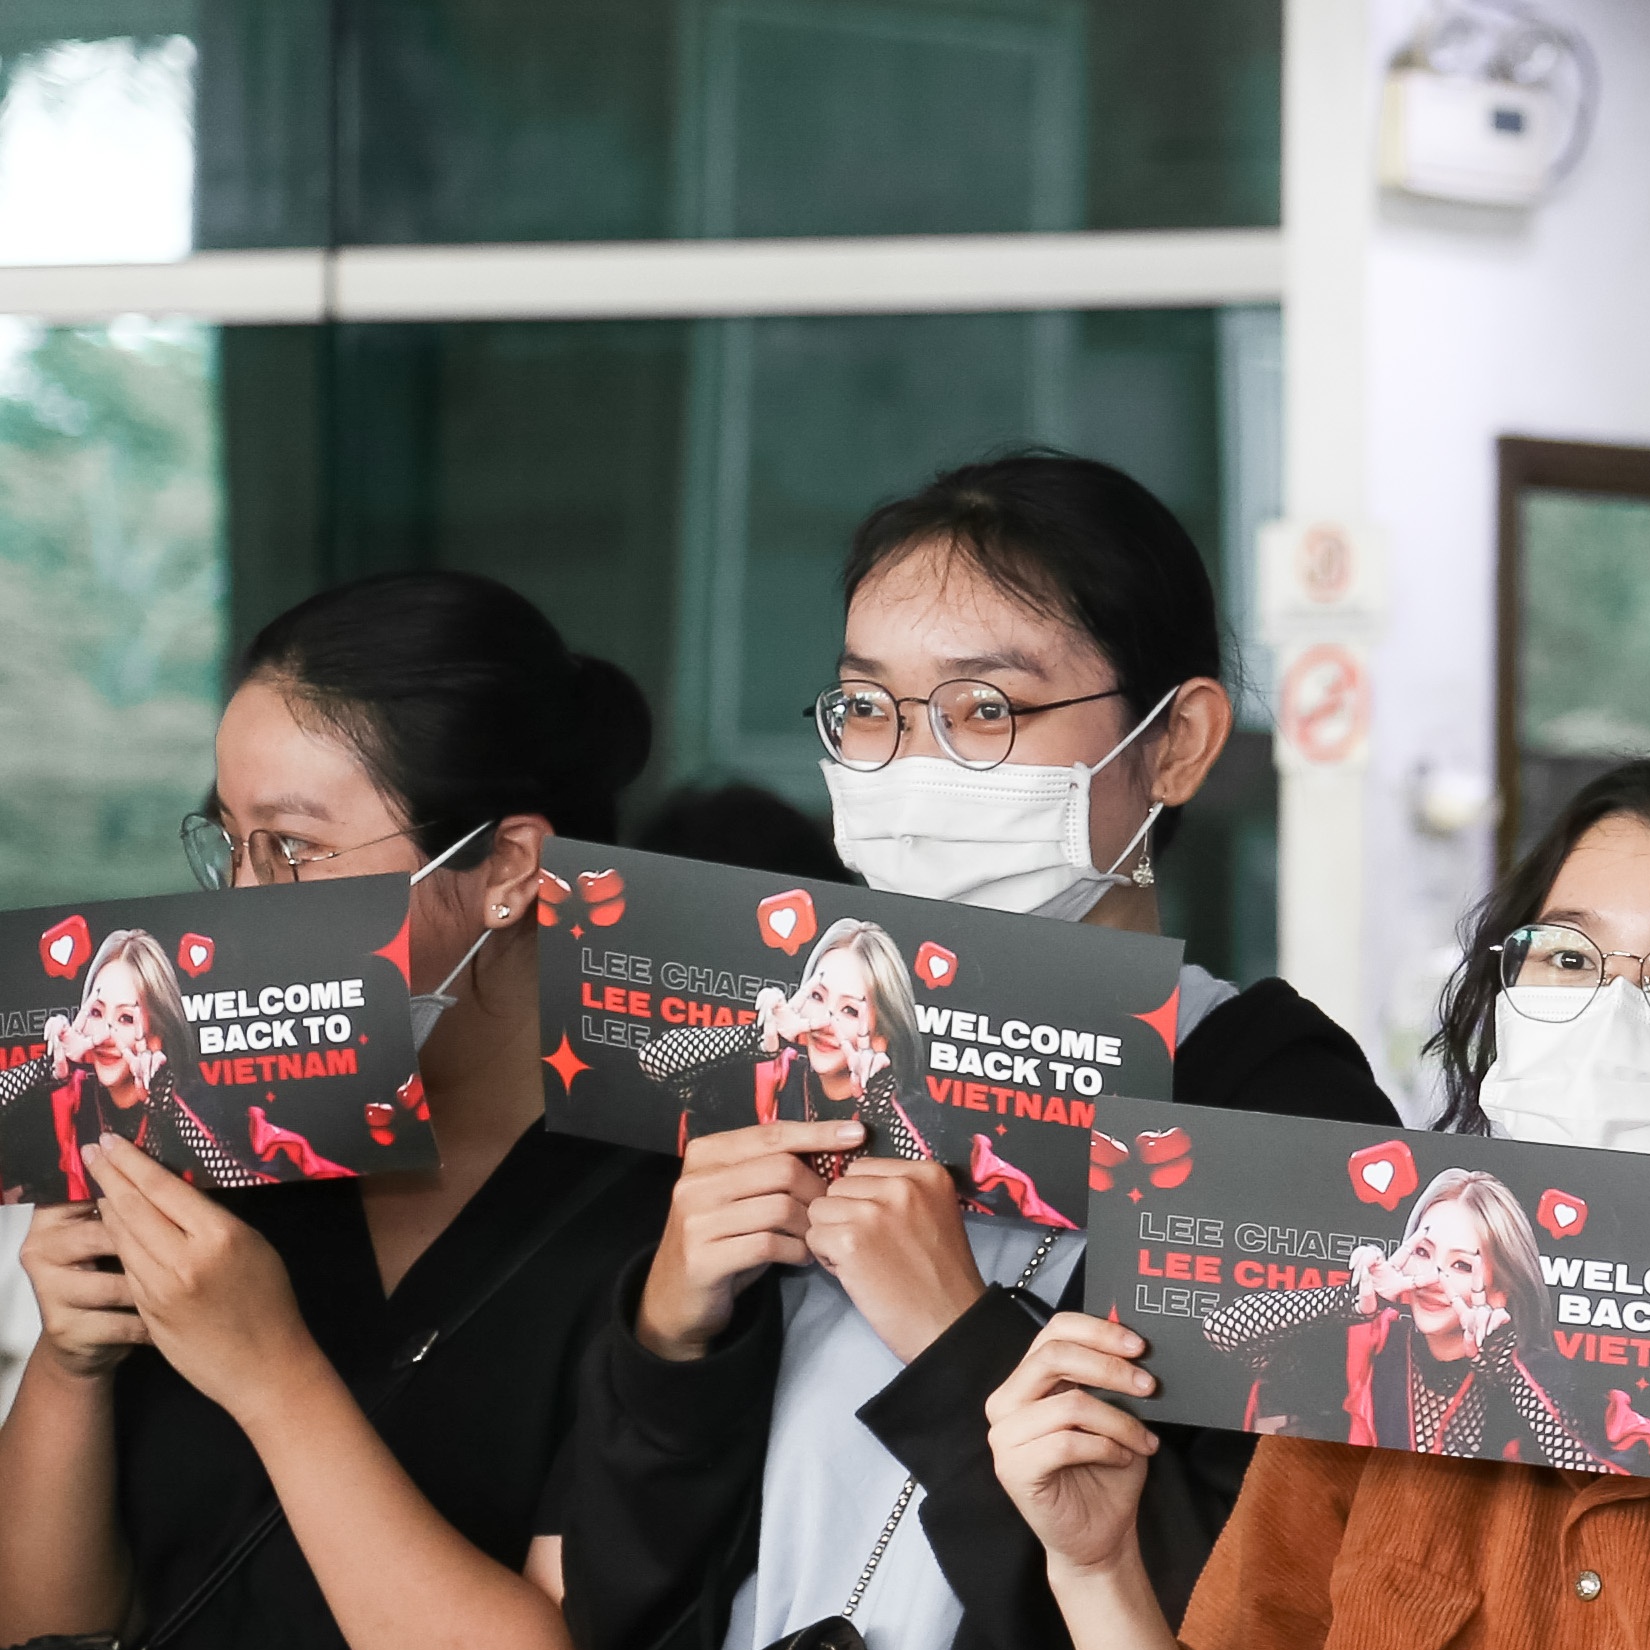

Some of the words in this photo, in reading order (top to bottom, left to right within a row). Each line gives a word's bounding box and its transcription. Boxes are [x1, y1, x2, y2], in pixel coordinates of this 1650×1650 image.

[582, 947, 652, 985] LEE
[181, 978, 365, 1022] WELCOME
[581, 981, 650, 1018] LEE
[200, 1017, 300, 1054] BACK
[303, 1012, 353, 1044] TO
[915, 1004, 1122, 1067] WELCOME
[200, 1046, 359, 1087] VIETNAM
[930, 1040, 1041, 1088] BACK
[1049, 1060, 1103, 1098] TO
[926, 1076, 1095, 1131] VIETNAM
[1139, 1212, 1224, 1248] LEE
[1137, 1248, 1221, 1283] LEE
